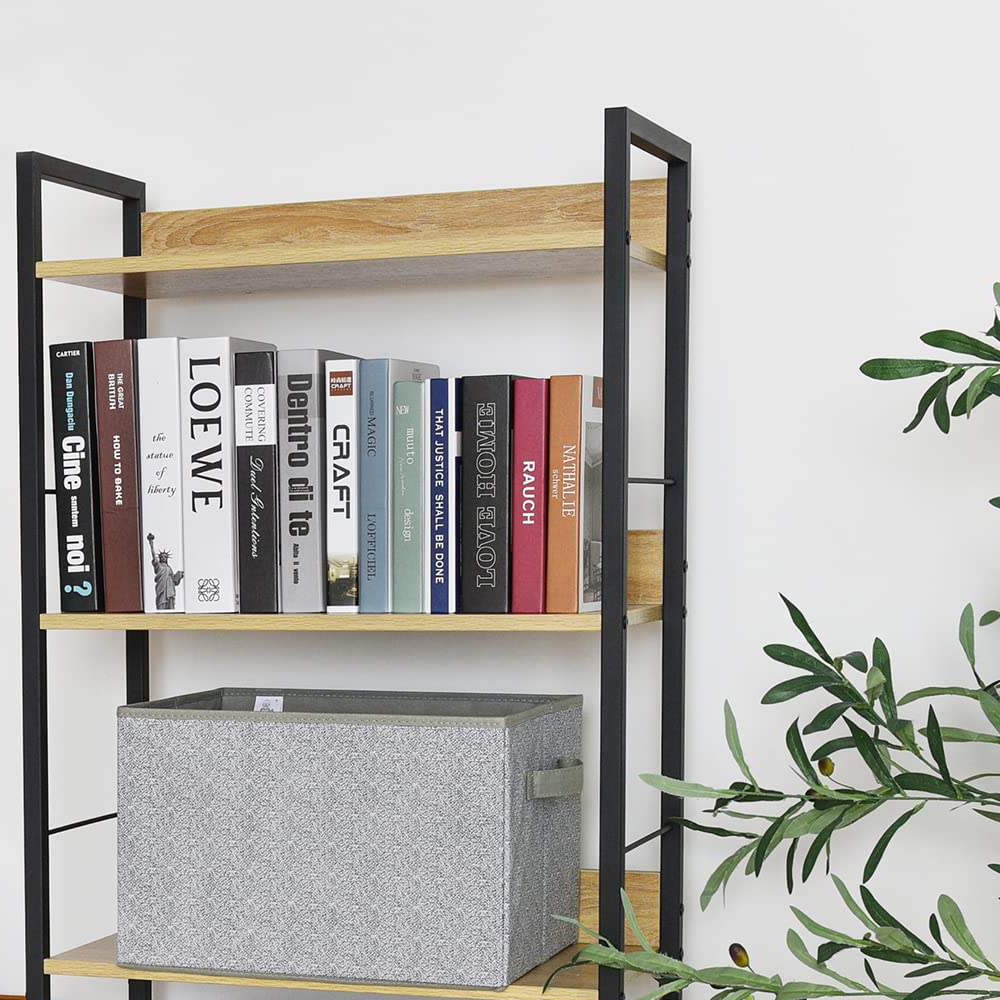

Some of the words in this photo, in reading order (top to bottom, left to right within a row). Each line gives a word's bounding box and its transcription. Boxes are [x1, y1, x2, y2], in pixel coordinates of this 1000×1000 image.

[56, 350, 80, 358] CARTIER
[65, 372, 74, 389] Dan
[108, 373, 116, 410] BRITISH
[117, 386, 125, 410] GREAT
[244, 387, 254, 442] COMMUTE
[256, 386, 267, 442] COVERING
[287, 374, 312, 468] Dentro
[434, 408, 444, 436] THAT
[112, 435, 121, 460] HOW
[152, 432, 166, 442] the
[189, 356, 223, 513] LOEWE
[367, 416, 376, 456] MAGIC
[406, 428, 415, 464] muuto
[476, 402, 496, 498] HOME
[61, 435, 86, 490] Cine
[114, 462, 122, 474] TO
[156, 466, 168, 480] of
[333, 424, 350, 519] CRAFT
[434, 441, 444, 487] JUSTICE
[114, 477, 123, 506] BAKE
[147, 484, 176, 498] liberty
[288, 478, 314, 502] di
[522, 461, 536, 525] RAUCH
[552, 468, 560, 500] schwer
[562, 444, 576, 518] NATHALIE
[288, 510, 312, 537] te
[402, 508, 413, 542] design
[435, 494, 444, 530] SHALL
[66, 534, 90, 573] noi
[367, 513, 377, 581] L'OFFICIEL
[435, 535, 444, 550] BE
[476, 506, 496, 588] LOVE
[435, 554, 444, 584] DONE
[64, 581, 93, 597] ?
